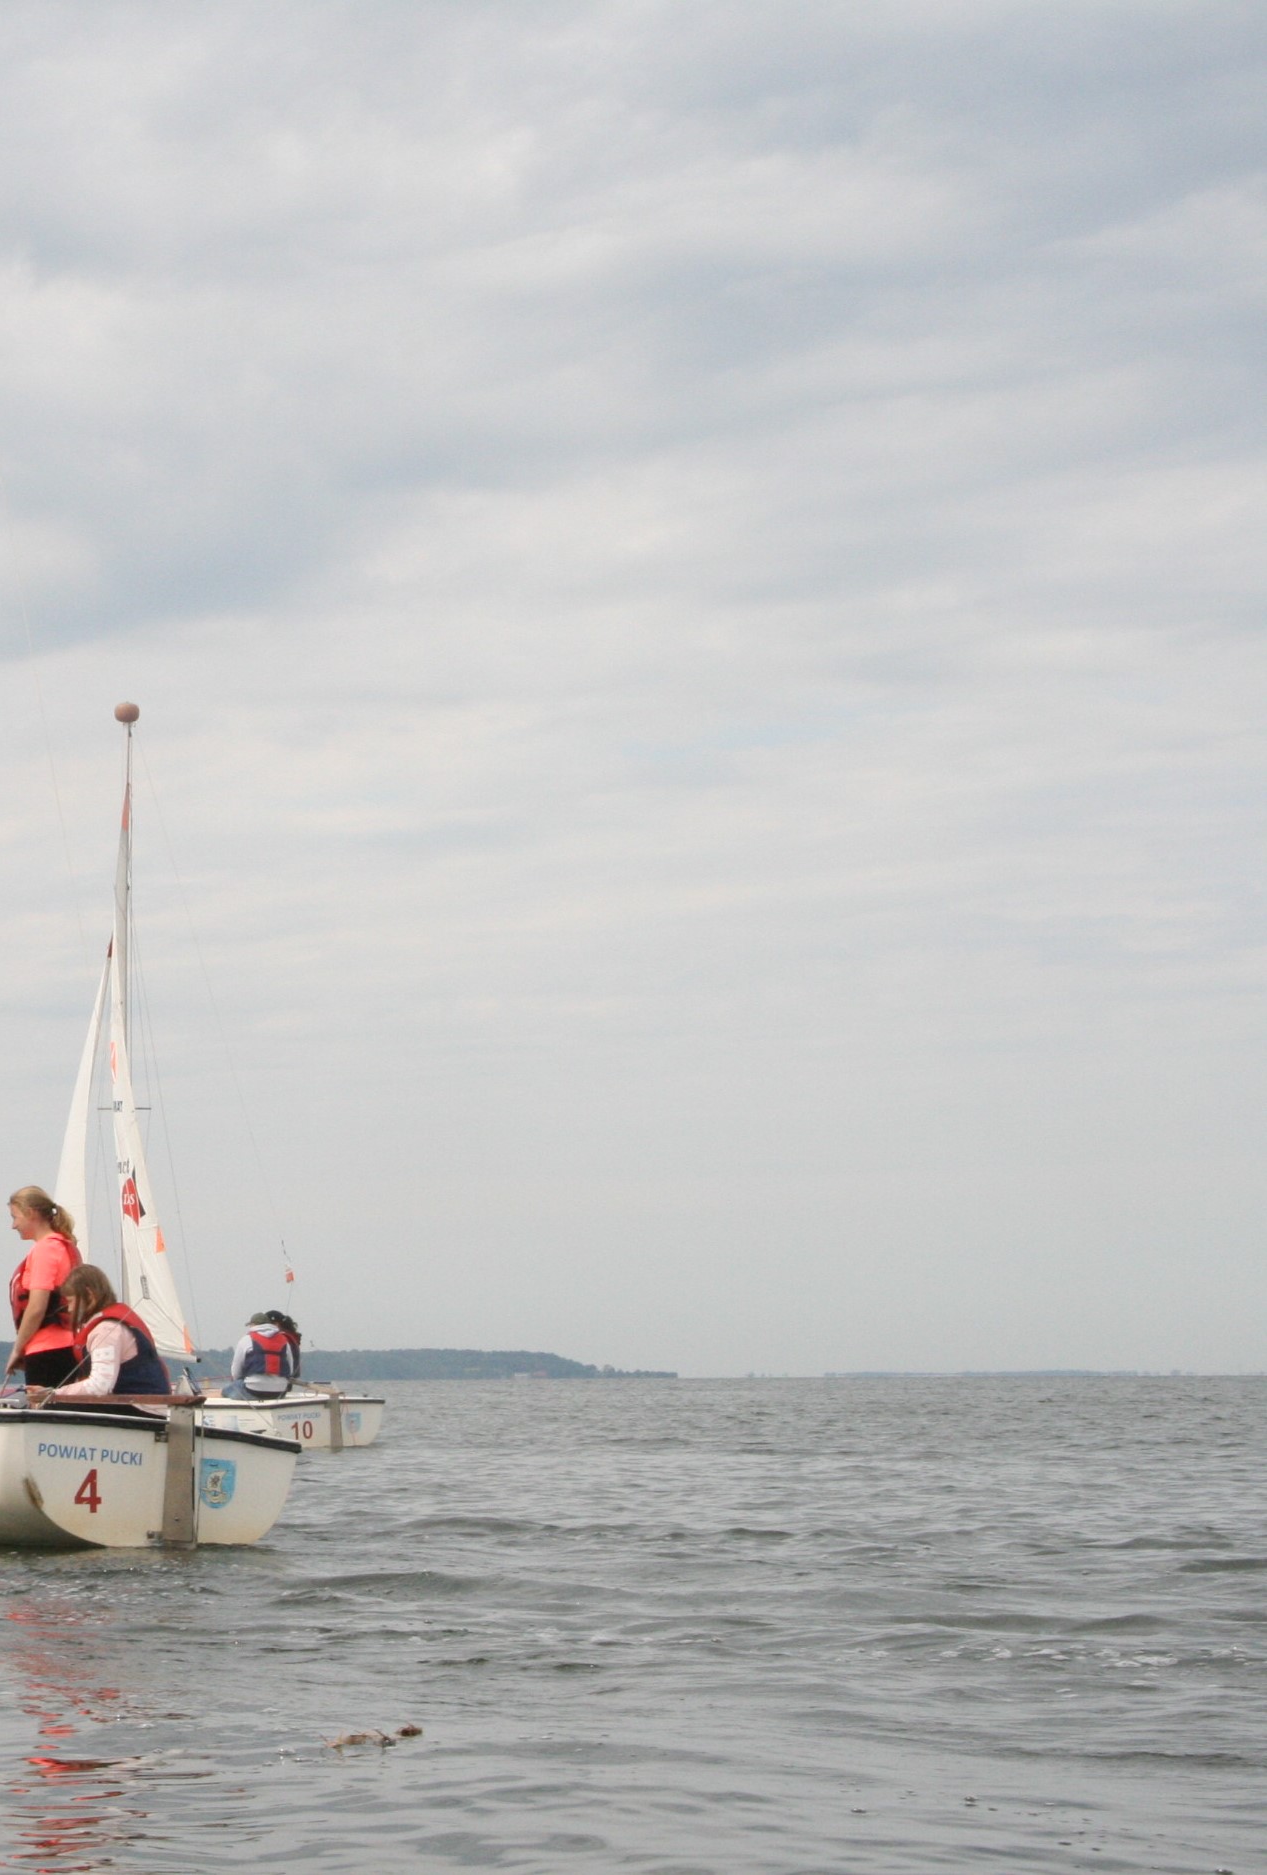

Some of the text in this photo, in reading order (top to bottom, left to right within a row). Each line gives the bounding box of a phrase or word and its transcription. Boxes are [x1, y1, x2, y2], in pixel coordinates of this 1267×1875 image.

[291, 1420, 314, 1441] 10
[38, 1442, 143, 1466] POWIAT PUCKI
[74, 1468, 102, 1514] 4
